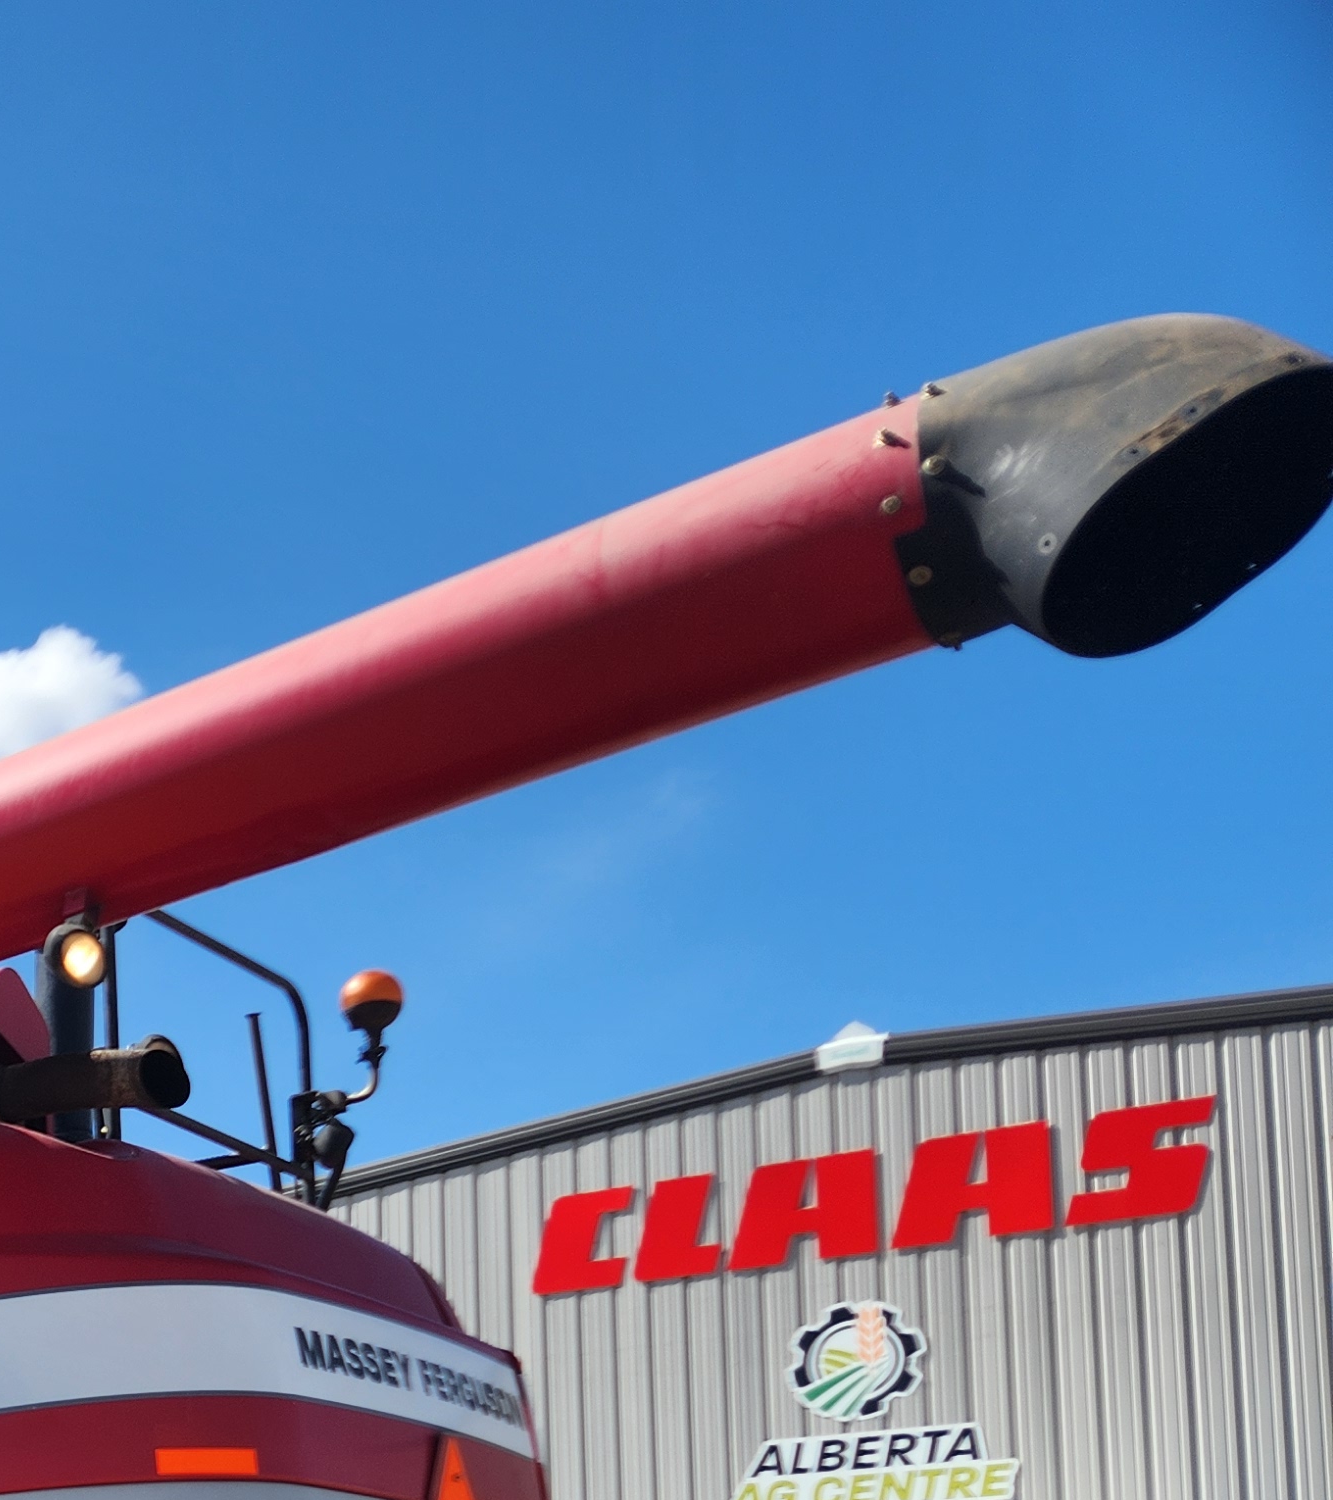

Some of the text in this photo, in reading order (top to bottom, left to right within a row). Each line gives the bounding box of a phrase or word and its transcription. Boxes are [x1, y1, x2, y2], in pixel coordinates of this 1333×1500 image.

[533, 1095, 1216, 1295] CLAAS
[294, 1326, 525, 1430] MASSEY FERGUSON
[751, 1427, 981, 1477] ALBERTA
